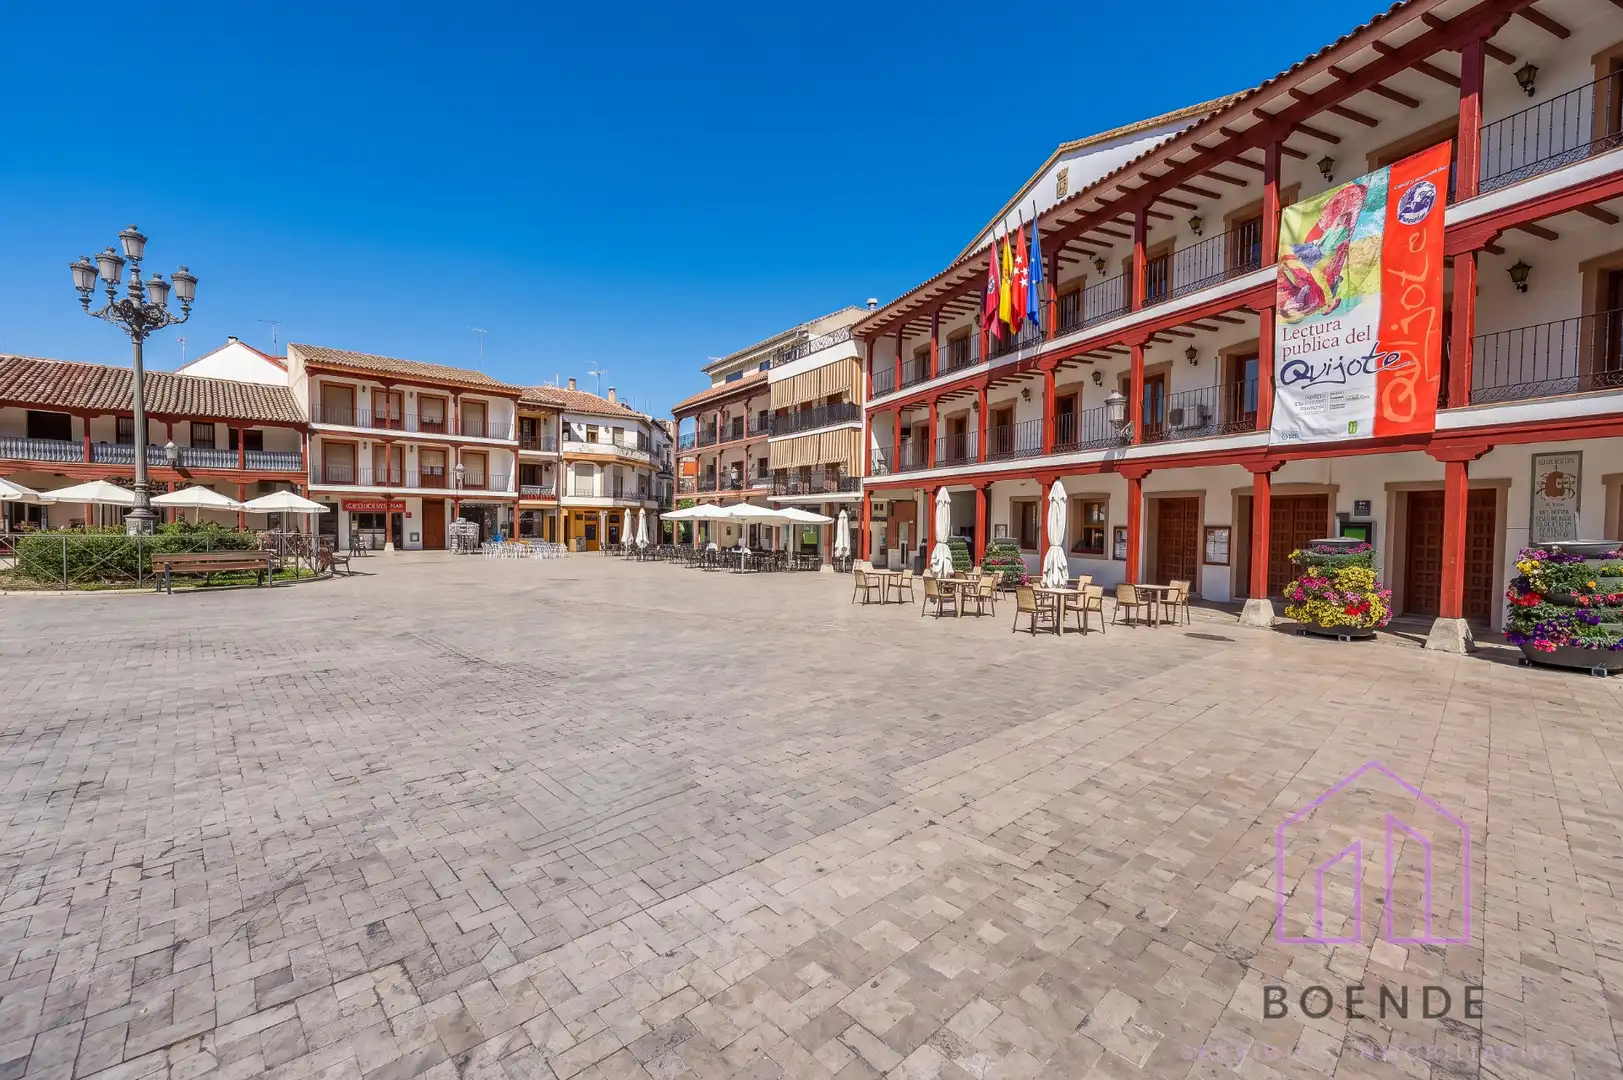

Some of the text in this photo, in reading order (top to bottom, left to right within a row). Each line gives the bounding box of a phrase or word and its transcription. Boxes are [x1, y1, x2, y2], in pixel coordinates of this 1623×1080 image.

[1282, 319, 1343, 342] Lectura
[1282, 325, 1371, 362] publica del
[1382, 228, 1440, 423] Quijote
[1280, 341, 1414, 390] Quijote
